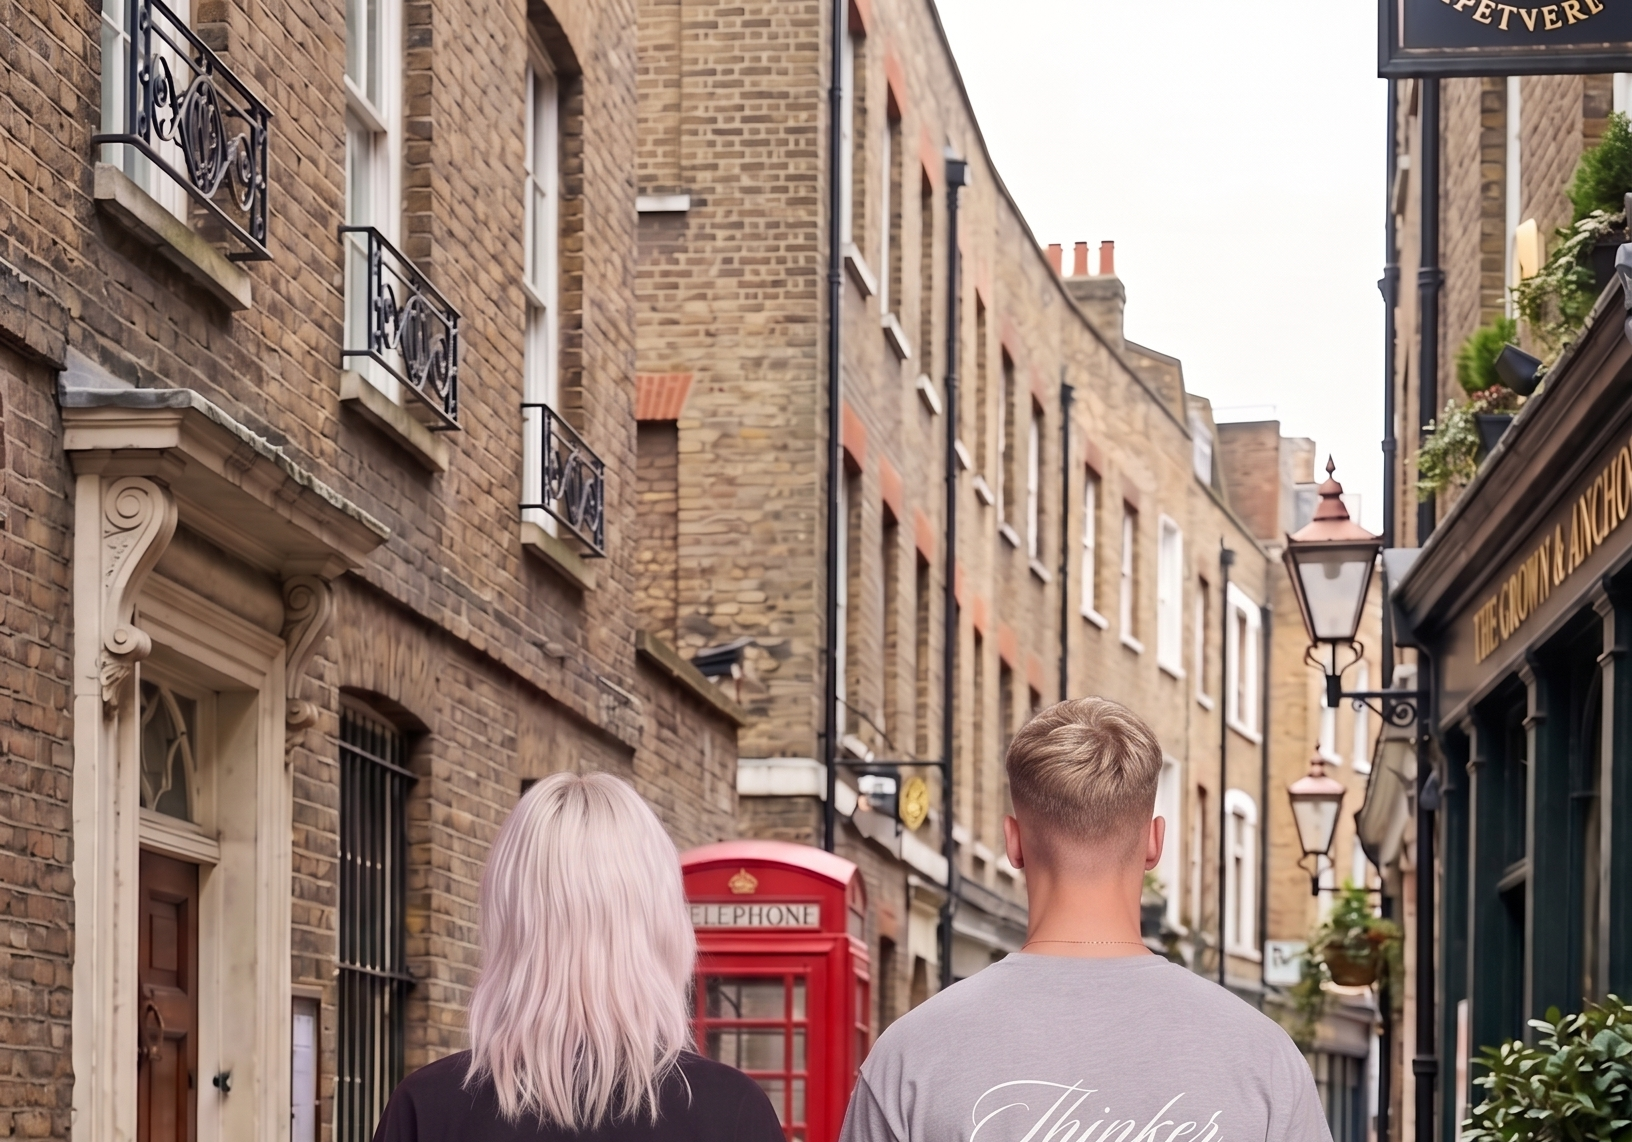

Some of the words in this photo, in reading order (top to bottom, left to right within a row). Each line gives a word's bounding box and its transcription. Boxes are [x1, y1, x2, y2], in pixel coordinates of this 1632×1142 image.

[1441, 0, 1604, 32] PETVER
[1473, 594, 1500, 665] THE
[1553, 523, 1566, 586] &
[1568, 435, 1632, 575] ANCHO
[690, 905, 816, 926] ELEPHONE
